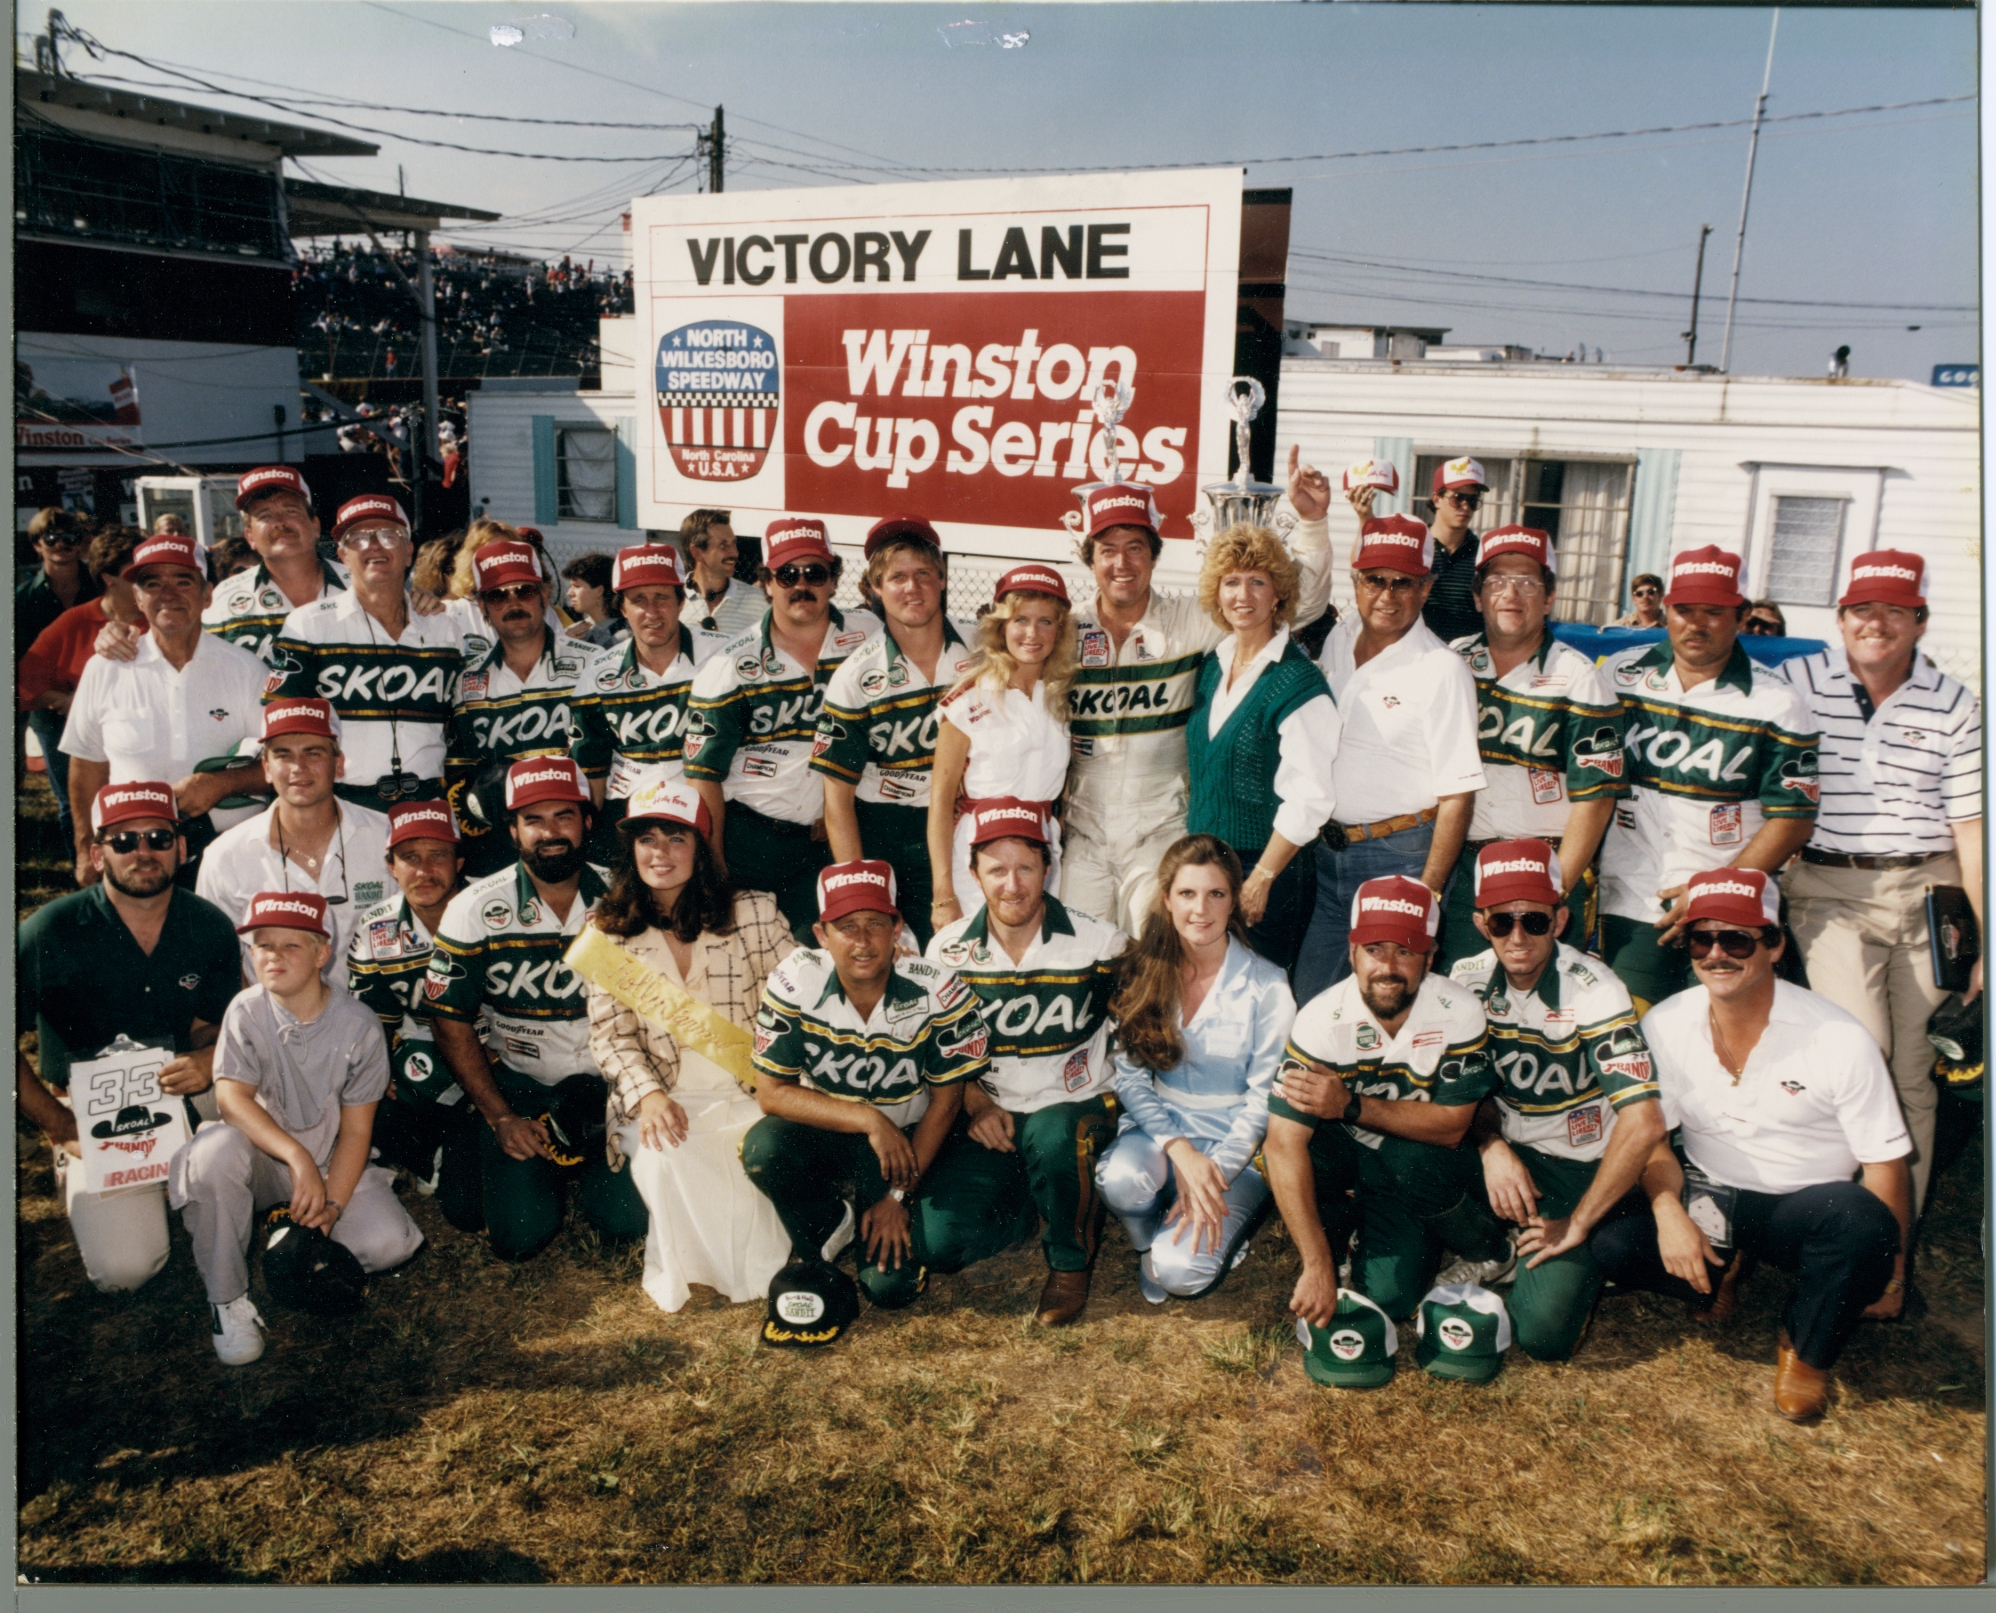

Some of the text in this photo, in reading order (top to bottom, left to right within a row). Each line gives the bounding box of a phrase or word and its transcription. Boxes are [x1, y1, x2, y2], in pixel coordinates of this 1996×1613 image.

[687, 222, 1131, 286] VICTORY LANE
[686, 328, 747, 347] NORTH
[661, 351, 775, 369] WILKESBORO
[842, 328, 1138, 400] Winston
[668, 371, 765, 390] SPEEDWAY
[803, 401, 1187, 489] Cup Series
[682, 448, 755, 463] North Carolina
[241, 467, 295, 489] Winston
[698, 462, 739, 477] U.S.A.
[339, 499, 392, 520] Winston
[1091, 495, 1145, 516] Winston
[770, 527, 823, 548] Winston
[1363, 532, 1419, 549] Winston
[1484, 531, 1541, 552] Winston
[135, 541, 189, 563] Winston
[479, 551, 529, 573] Winston
[622, 553, 673, 573] Winston
[1673, 561, 1735, 579] Winston
[1010, 572, 1060, 588] Winston
[1853, 563, 1915, 582] Winston
[566, 640, 599, 654] BANDIT
[725, 634, 756, 654] SKOAL
[316, 664, 457, 701] SKOAL
[1067, 682, 1169, 716] SKOAL
[267, 704, 325, 725] Winston
[744, 743, 790, 757] GOODYEAR
[746, 762, 776, 773] CHAMPION
[879, 769, 928, 783] GOODYEAR
[513, 768, 573, 789] Winston
[1534, 777, 1547, 786] LIVE
[1535, 781, 1557, 793] LIBERTY
[104, 788, 169, 808] Winston
[883, 784, 914, 797] CHAMPION
[393, 808, 448, 830] Winston
[978, 806, 1038, 827] Winston
[1712, 812, 1728, 821] LONG
[1713, 819, 1728, 827] LIVE
[1713, 823, 1738, 833] LIBERTY
[1482, 857, 1546, 878] Winston
[353, 881, 385, 891] SKOAL
[473, 876, 509, 895] SKOAL
[825, 871, 886, 892] Winston
[1690, 879, 1755, 902] Winston
[354, 890, 384, 900] BANDIT
[254, 898, 319, 920] Winston
[1361, 896, 1424, 919] Winston
[373, 934, 387, 942] LIVE
[496, 1020, 545, 1037] GOODYEAR
[88, 1061, 165, 1117] 33
[115, 1119, 151, 1133] SKOAL
[1571, 1114, 1587, 1124] LONG
[1571, 1121, 1587, 1131] LIVE
[1572, 1125, 1598, 1137] LIBERTY
[114, 1137, 158, 1160] BANDIT
[785, 1308, 817, 1318] BANDIT
